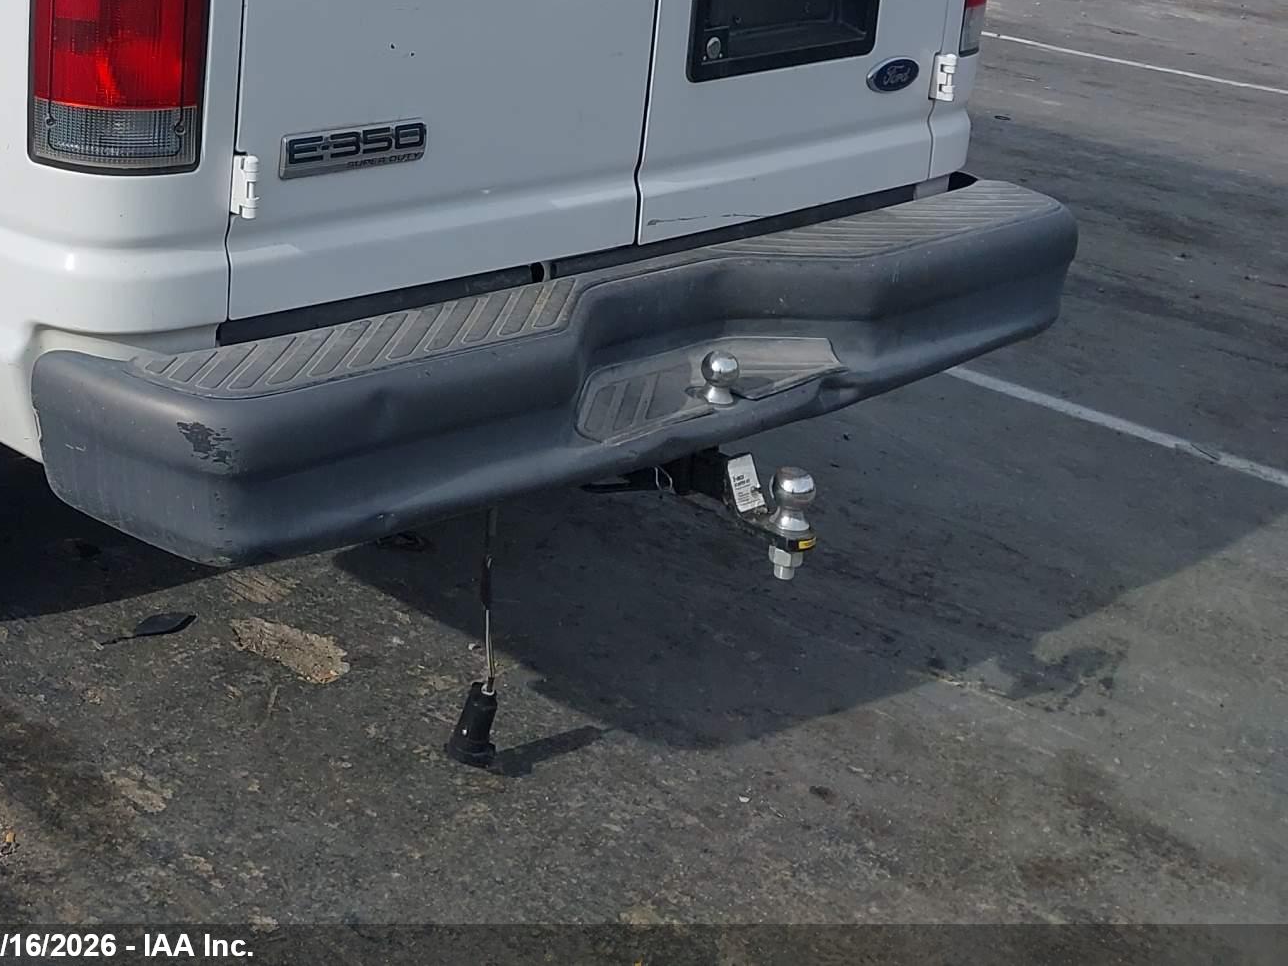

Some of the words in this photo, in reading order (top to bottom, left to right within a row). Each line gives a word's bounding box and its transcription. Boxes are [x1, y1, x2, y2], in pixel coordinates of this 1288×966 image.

[882, 64, 911, 86] Ford
[288, 121, 427, 164] E-350
[348, 156, 386, 170] SUPER
[388, 151, 426, 164] DUTY
